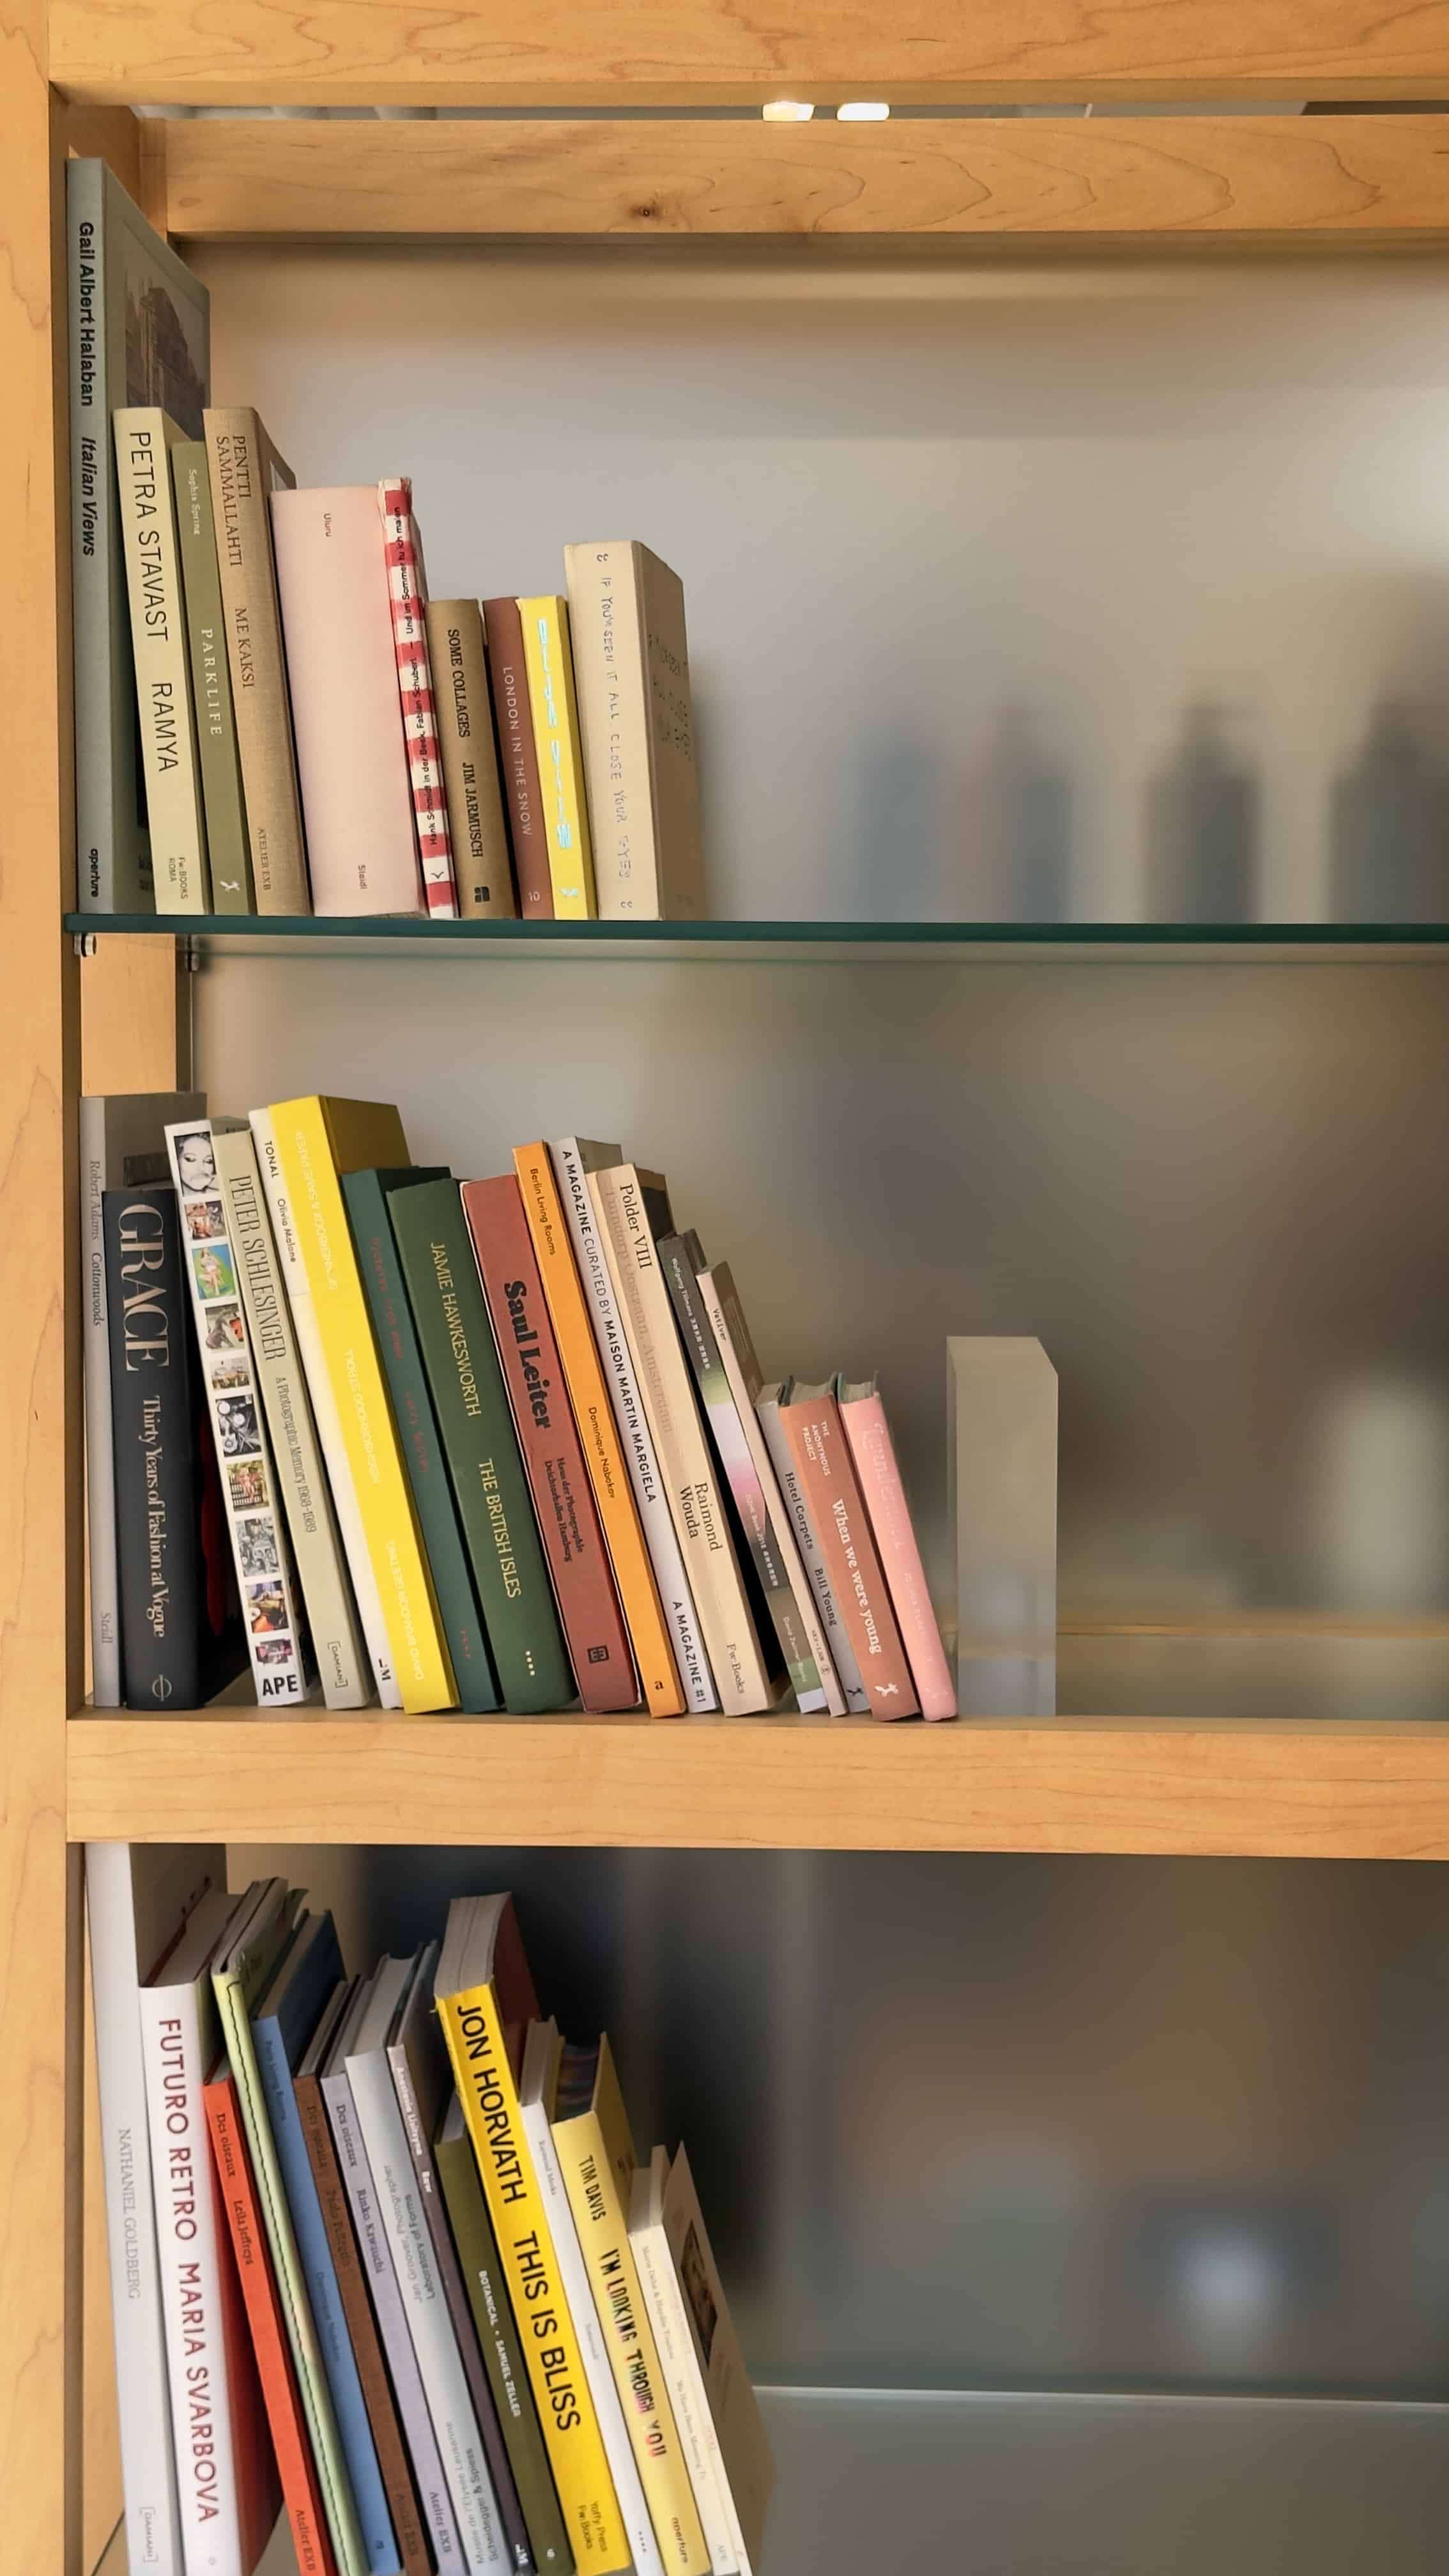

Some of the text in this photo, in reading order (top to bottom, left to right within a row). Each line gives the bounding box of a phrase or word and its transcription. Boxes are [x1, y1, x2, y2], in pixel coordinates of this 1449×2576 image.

[79, 222, 95, 406] Gail Albert Halaban
[81, 436, 97, 556] Italian Views
[216, 435, 241, 565] SAMMALLAHTI
[233, 434, 250, 498] PENTTI
[323, 513, 332, 536] Uluru
[395, 535, 404, 549] ich
[129, 430, 179, 772] PETRA STAVAST RAMYA
[398, 563, 410, 600] Sommer
[402, 602, 411, 613] im
[234, 607, 254, 687] ME KAKSI
[404, 616, 413, 634] Und
[601, 576, 611, 586] IF
[608, 671, 618, 680] IT
[201, 627, 222, 735] PARKLIFE
[420, 757, 429, 772] der
[447, 628, 484, 858] SOME COLLAGES JIM JARMUSCH
[502, 666, 532, 836] LONDON IN THE SNOW
[88, 848, 100, 897] aperture
[168, 857, 176, 882] ROMA
[257, 827, 269, 868] ATELIER
[428, 823, 438, 845] Hank
[528, 891, 540, 902] 10
[264, 1140, 298, 1262] TONAL Olivia Malone
[530, 1167, 556, 1256] Berlin Living Rooms
[562, 1149, 594, 1235] A MAGAZINE
[617, 1182, 654, 1269] Polder VIII
[89, 1160, 104, 1326] Robert Adams Cottonwoods
[228, 1174, 287, 1361] PETER SCHLESINGER
[583, 1237, 611, 1316] CURATED BY
[118, 1203, 169, 1371] GRACE
[430, 1240, 482, 1416] JAMIE HAWKESWORTH
[711, 1308, 728, 1341] Vetiver
[503, 1278, 558, 1430] Saul Leiter
[603, 1319, 625, 1372] MAISON
[642, 1342, 675, 1435] Amsterdam
[587, 1406, 617, 1499] Dominique Nabokov
[617, 1376, 657, 1503] MARTIN MARGIELA
[801, 1426, 817, 1462] PROJECT
[810, 1423, 831, 1476] ANONYMOUS
[820, 1420, 830, 1437] THE
[137, 1395, 169, 1637] Thirty Years of Fashion at Vogue
[478, 1457, 522, 1598] THE BRITISH ISLES
[678, 1485, 702, 1538] Wouda
[694, 1481, 723, 1551] Raimond
[784, 1471, 801, 1503] Hotel
[814, 1567, 838, 1627] Bill Young
[831, 1498, 884, 1655] When we were young
[260, 1674, 298, 1696] APE
[671, 1599, 706, 1703] A MAGAZINE #1
[158, 2018, 198, 2240] FUTURO RETRO
[215, 2112, 237, 2177] Des oiseaux
[335, 2103, 358, 2167] Des oiseaux
[457, 2000, 527, 2204] JON HORVATH
[118, 2128, 141, 2299] NATHANIEL GOLDBERG
[233, 2199, 247, 2227] Leila
[356, 2188, 372, 2220] Rinko
[577, 2154, 607, 2221] TIM DAVIS
[402, 2193, 436, 2299] Laboratory of Forms
[478, 2269, 521, 2417] BOTANICAL SAMUEL ZELLER
[512, 2230, 582, 2432] THIS IS BLISS
[596, 2248, 667, 2457] I'M LOOKING THROUGH YOU
[178, 2261, 220, 2522] MARIA SVARBOVA
[429, 2490, 445, 2526] Atelier
[595, 2525, 610, 2552] Press
